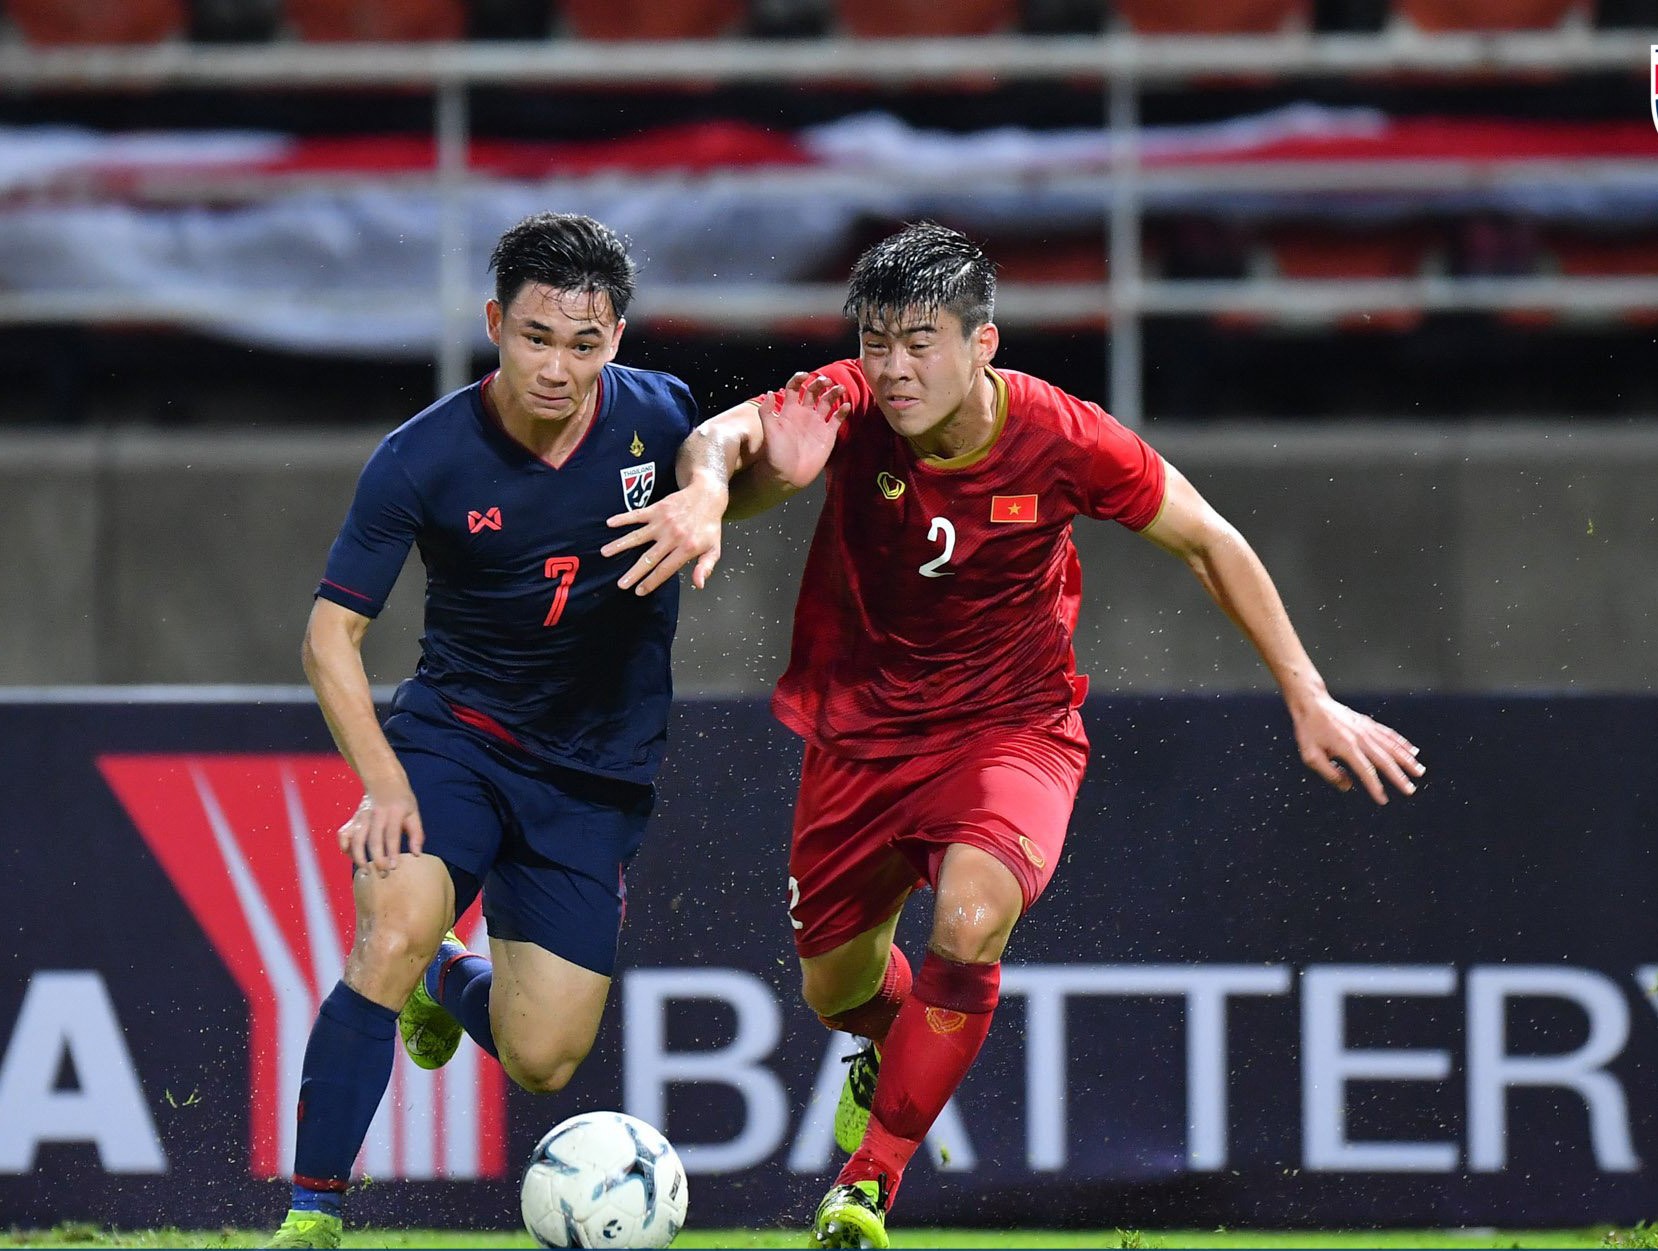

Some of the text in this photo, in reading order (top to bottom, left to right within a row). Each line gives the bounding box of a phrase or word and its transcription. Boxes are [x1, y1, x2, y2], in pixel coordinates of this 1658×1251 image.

[623, 464, 654, 477] THAILAND
[918, 516, 956, 578] 2
[543, 556, 580, 626] 7
[624, 964, 1658, 1173] BTTER
